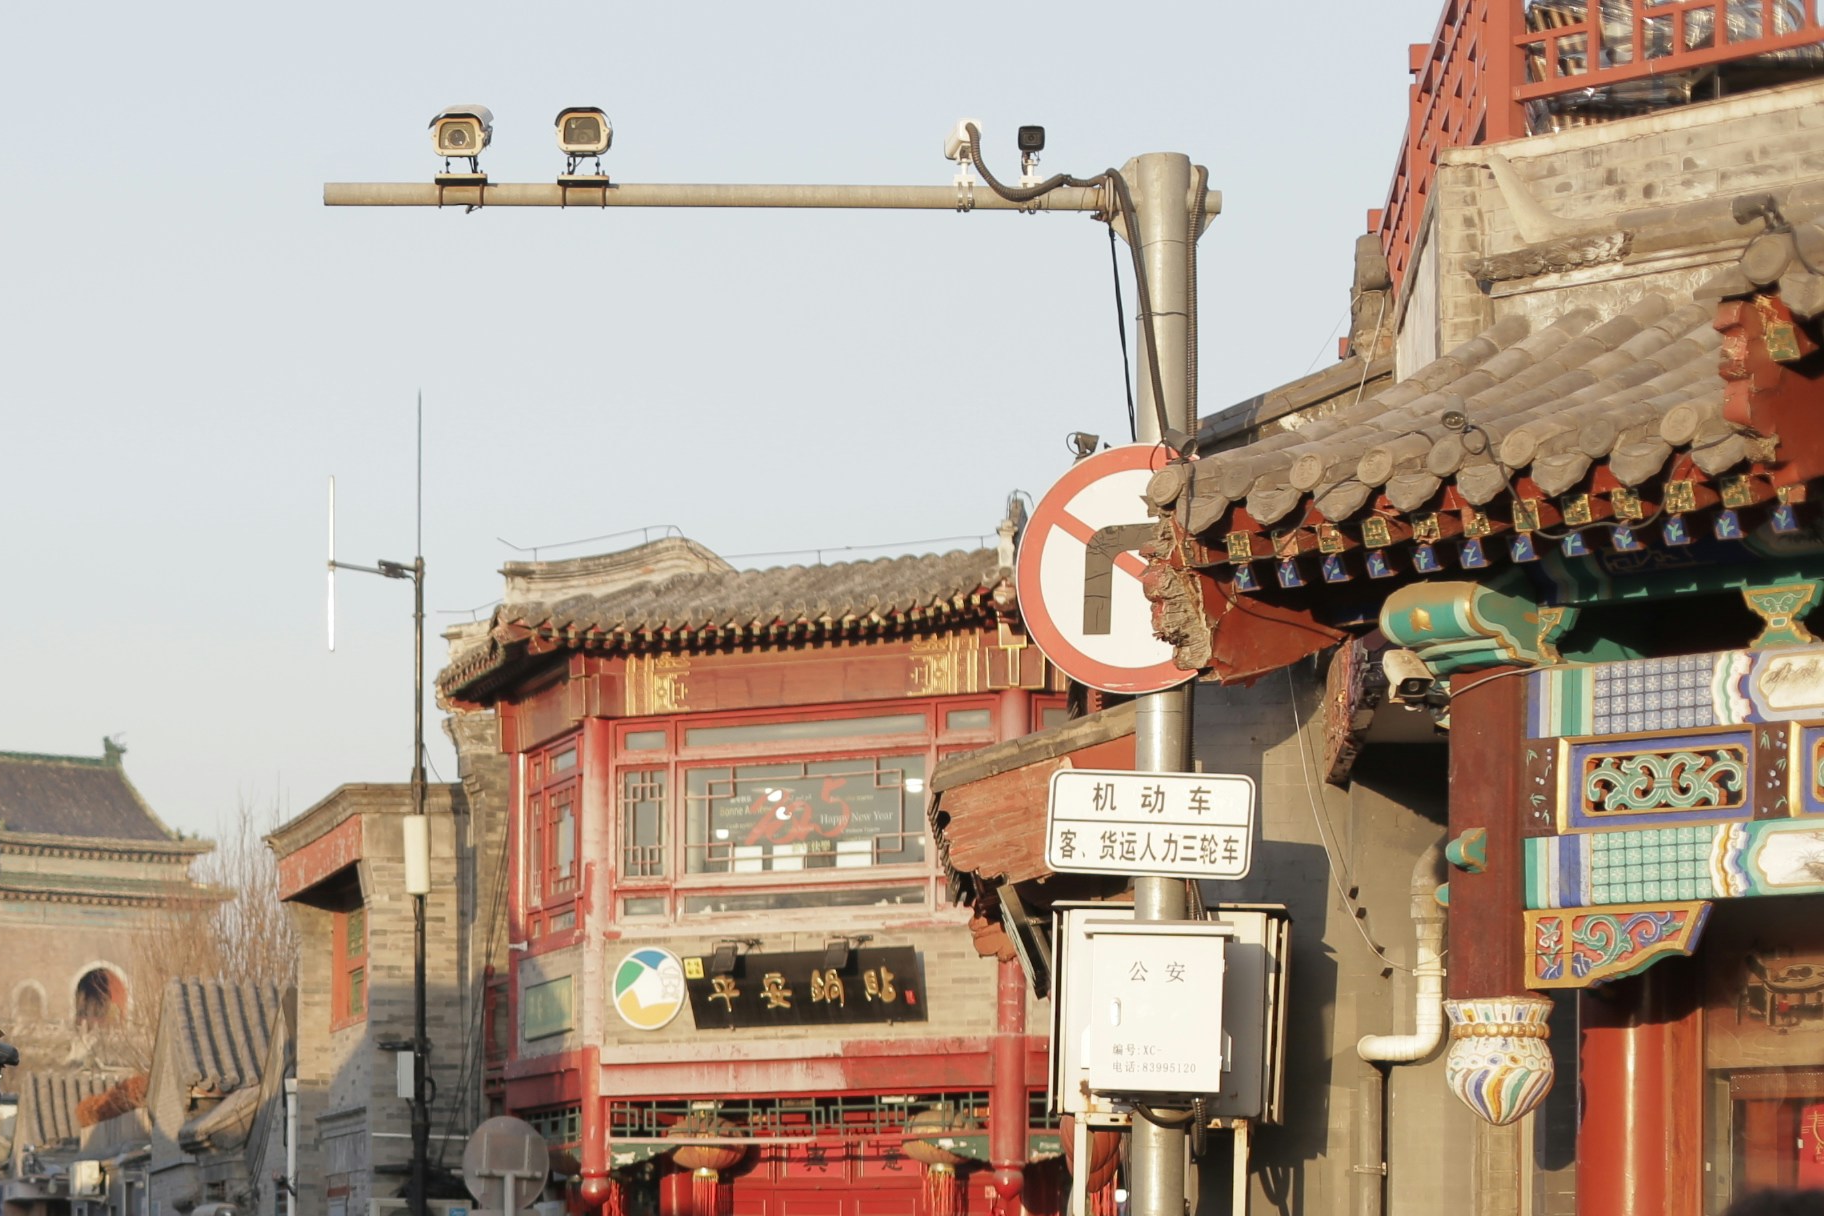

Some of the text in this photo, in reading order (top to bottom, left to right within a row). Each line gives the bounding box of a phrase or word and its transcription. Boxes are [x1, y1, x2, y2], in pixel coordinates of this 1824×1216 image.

[1092, 782, 1212, 815] 机动车
[820, 810, 894, 825] Happy New Year
[1059, 828, 1240, 865] 客、货运人力三轮车
[1128, 960, 1186, 983] 公安
